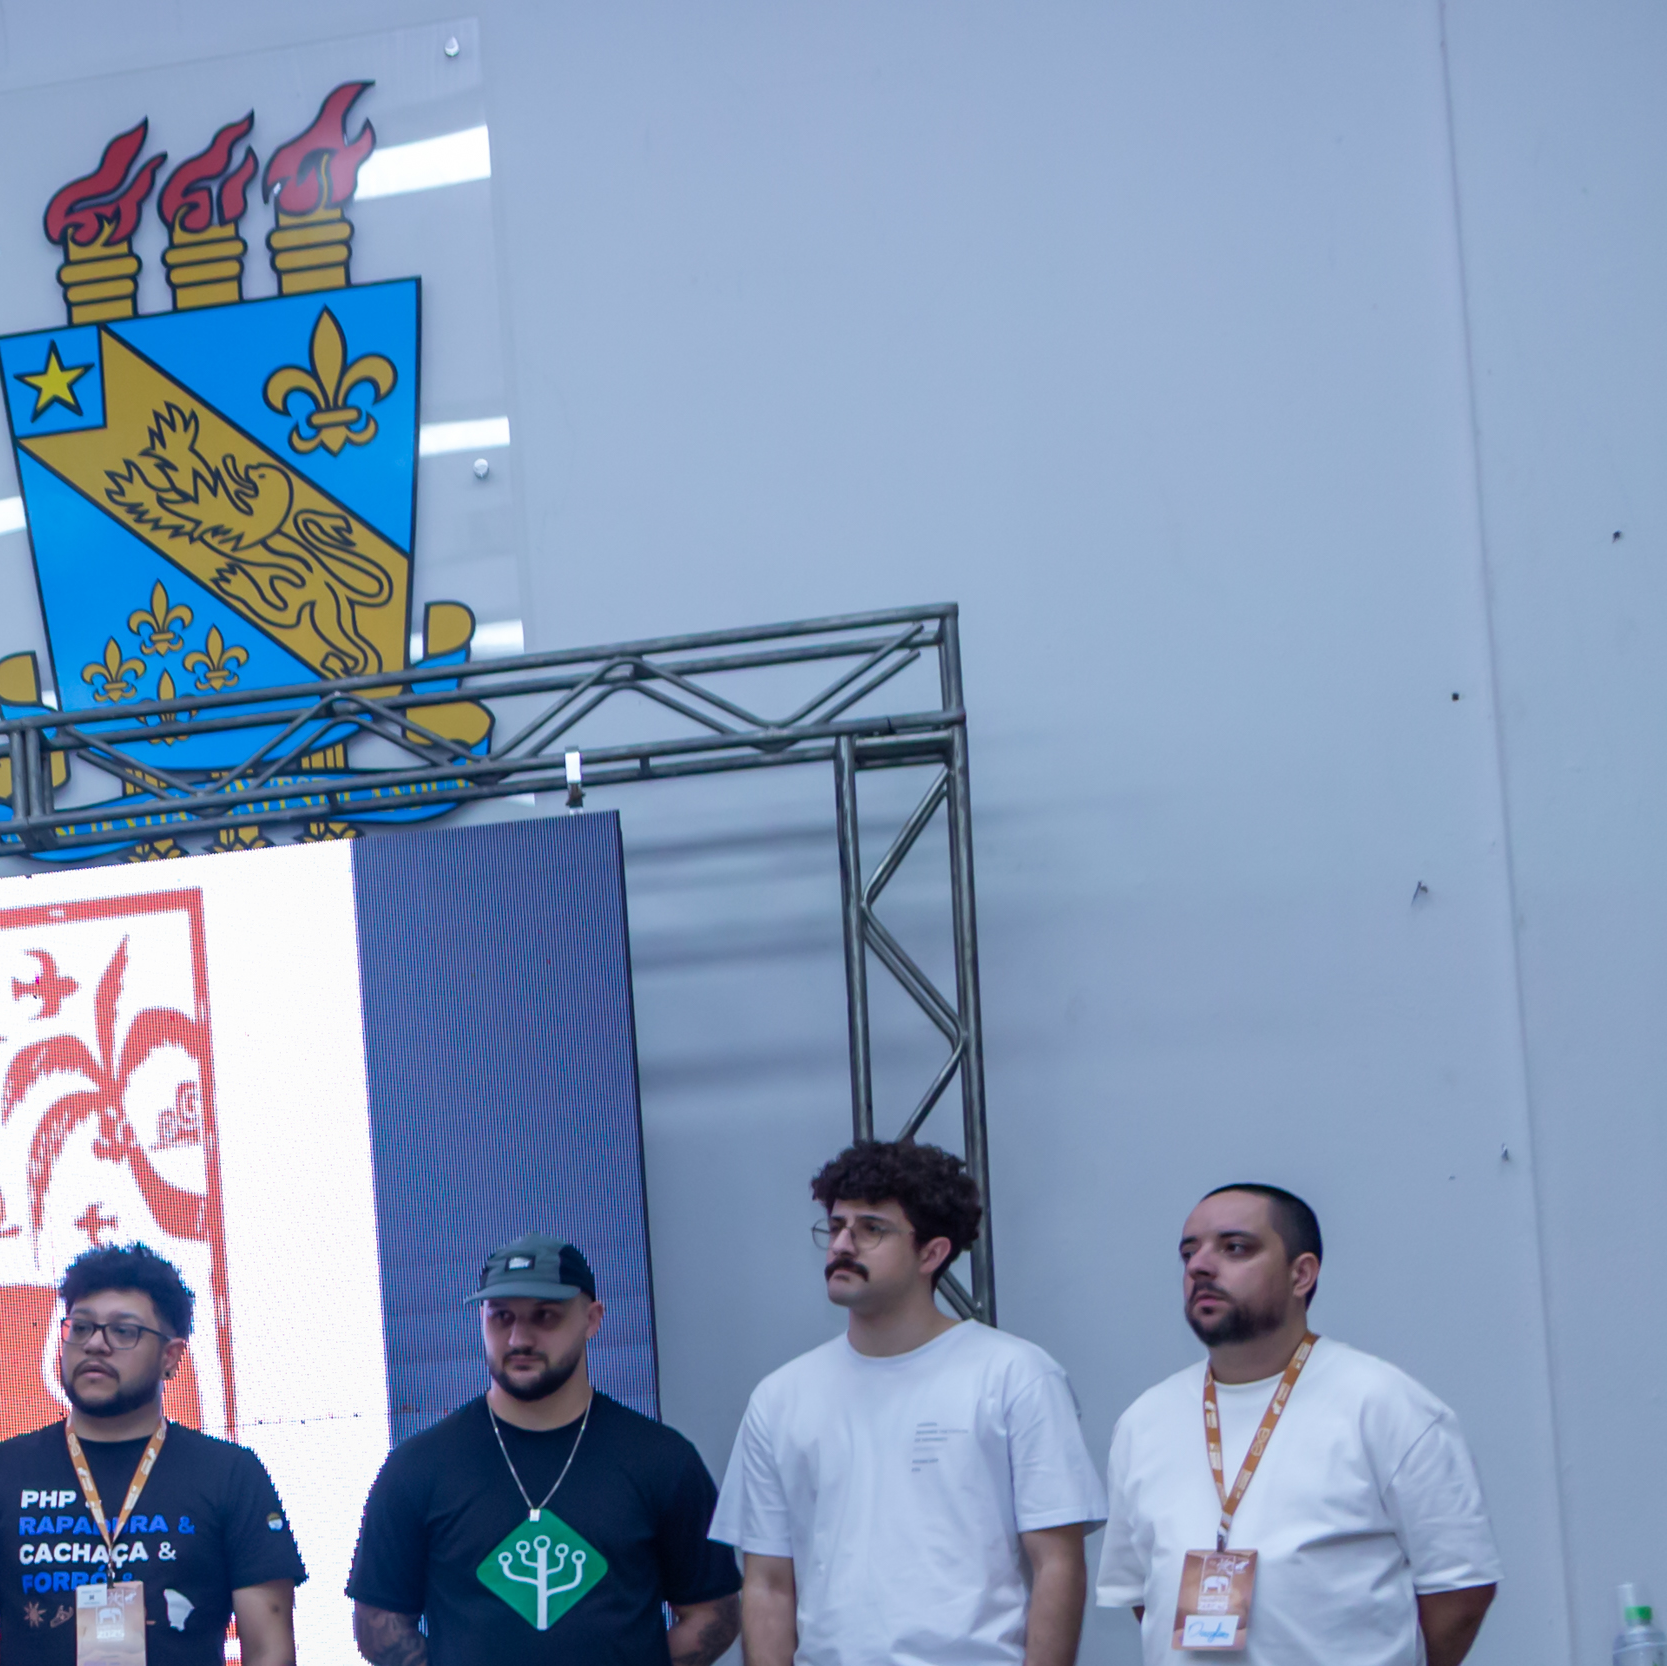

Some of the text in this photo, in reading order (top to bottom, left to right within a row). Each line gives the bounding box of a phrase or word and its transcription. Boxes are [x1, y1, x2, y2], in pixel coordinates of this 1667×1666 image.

[21, 1489, 77, 1509] PHP
[178, 1516, 195, 1535] &
[19, 1541, 177, 1569] CACHAÇA &
